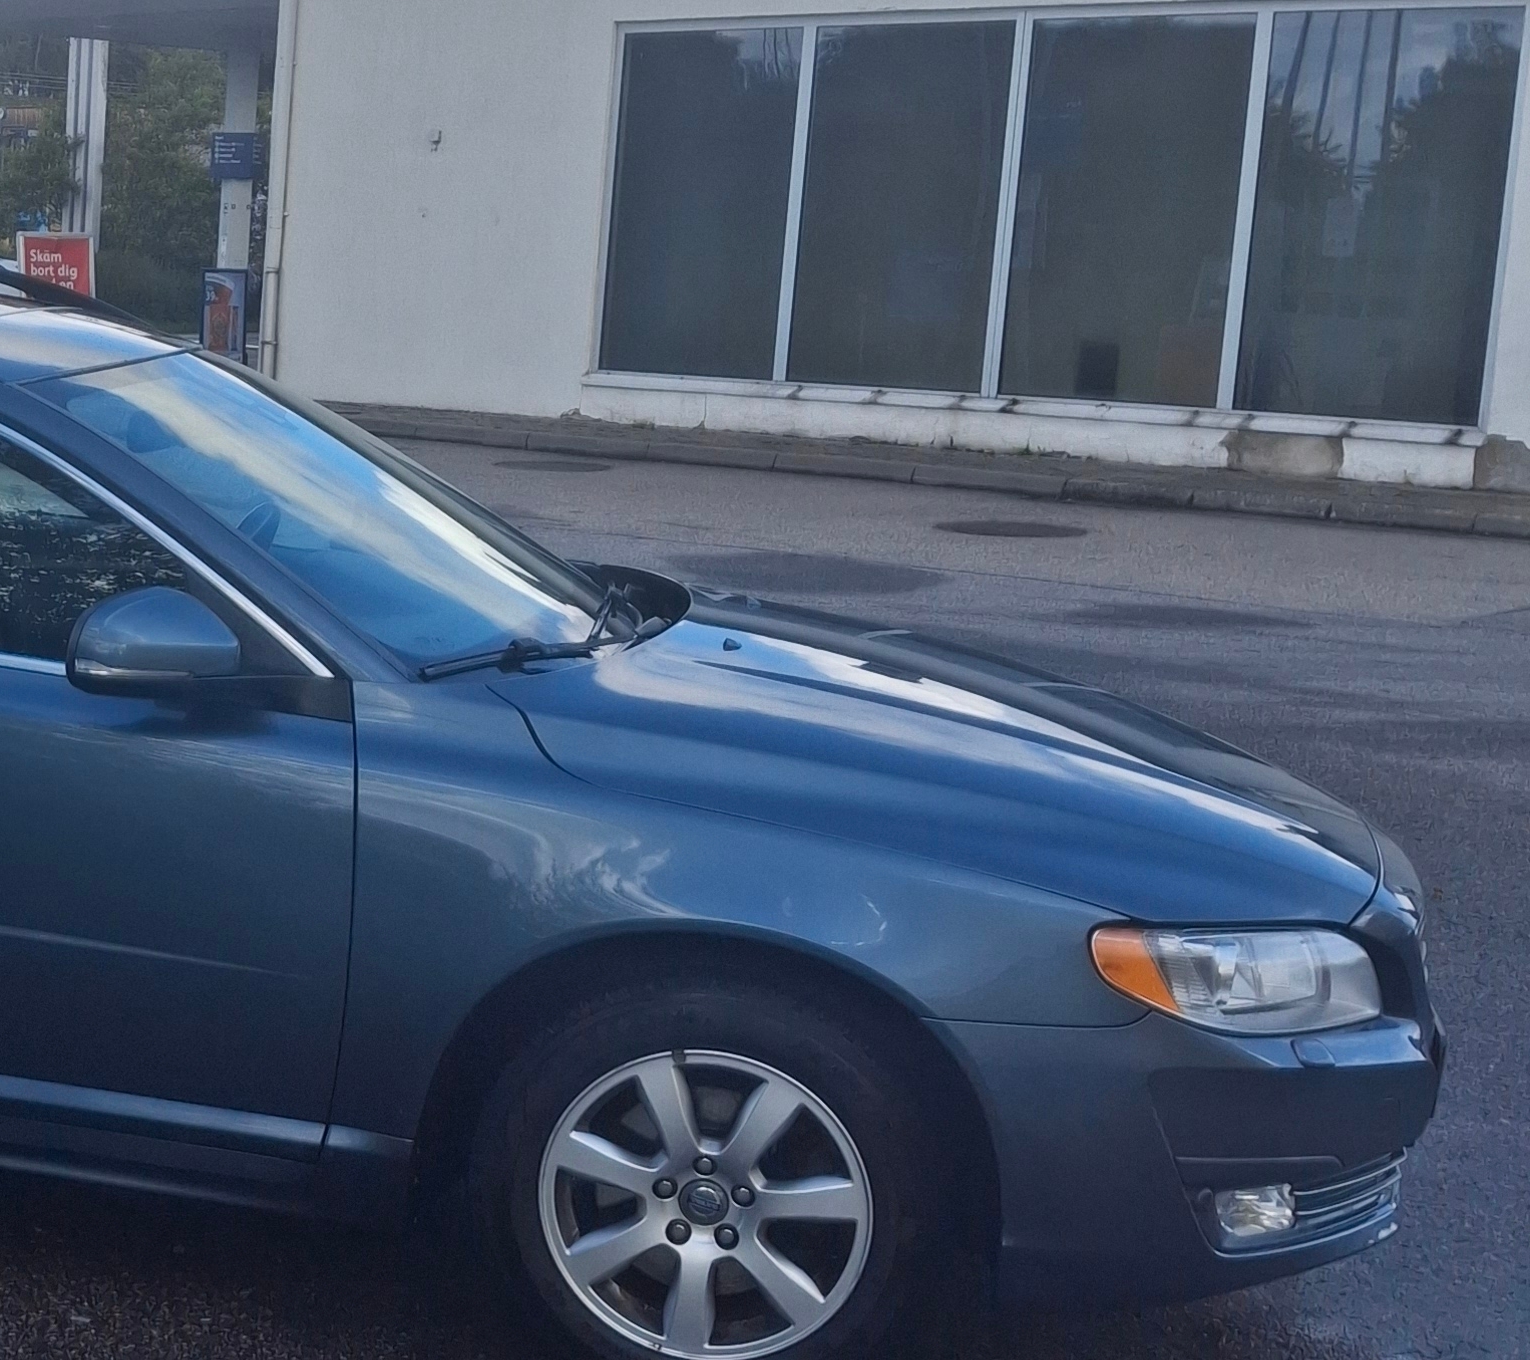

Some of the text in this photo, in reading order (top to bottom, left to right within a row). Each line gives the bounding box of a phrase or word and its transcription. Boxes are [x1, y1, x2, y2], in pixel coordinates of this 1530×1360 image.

[30, 249, 62, 262] Skäm
[31, 264, 78, 280] bort dig
